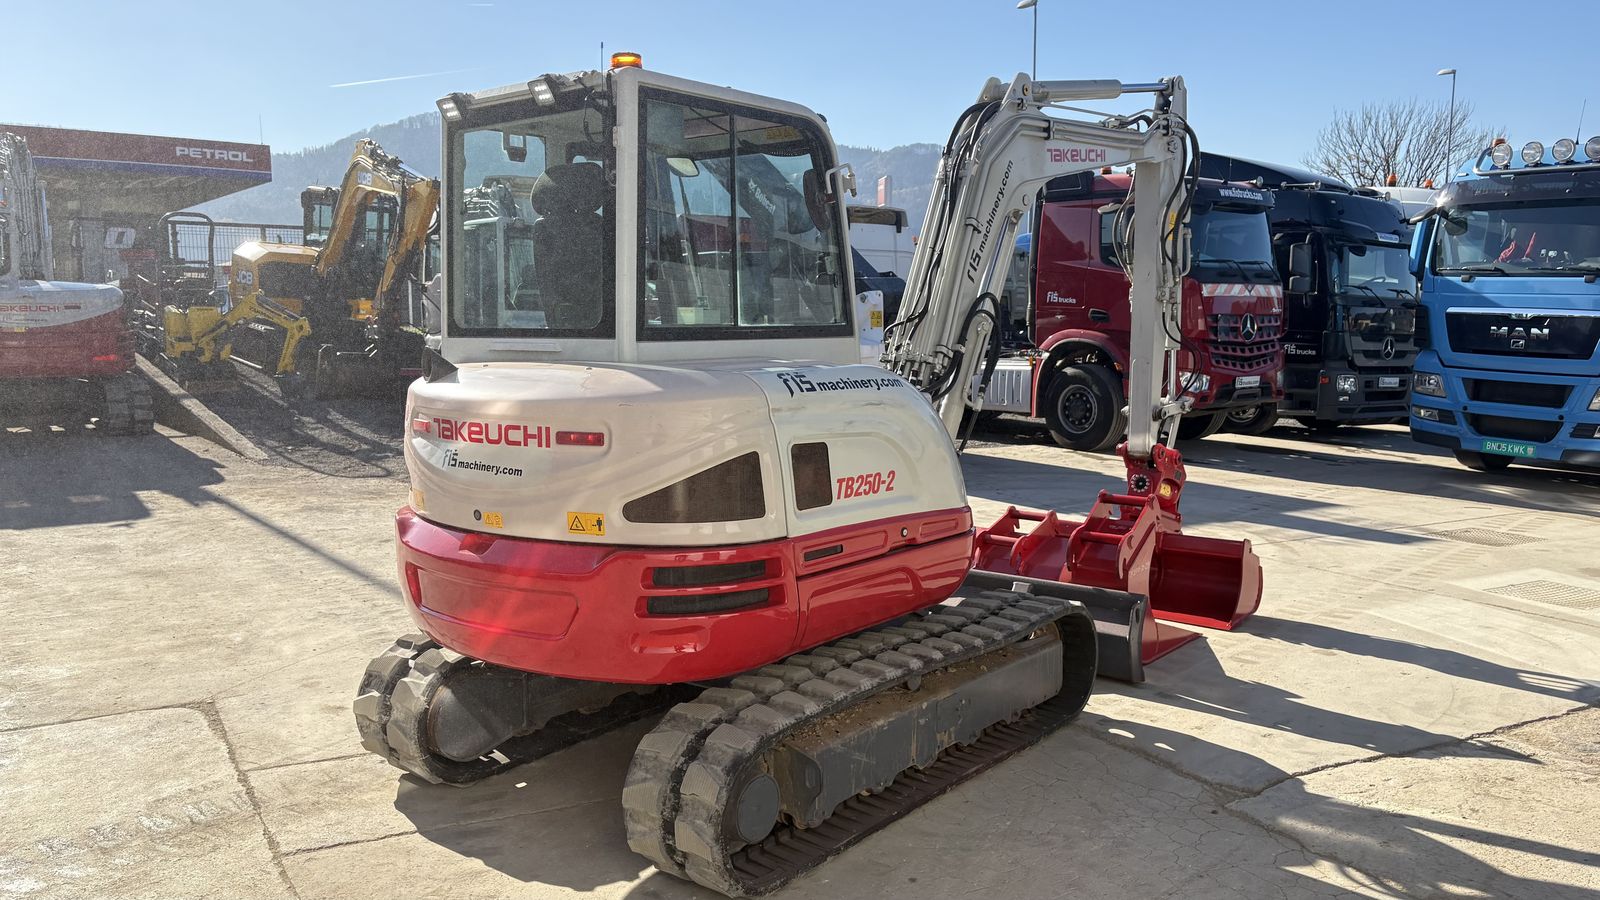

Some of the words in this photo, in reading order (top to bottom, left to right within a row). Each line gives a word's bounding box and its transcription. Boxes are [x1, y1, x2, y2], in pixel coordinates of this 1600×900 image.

[175, 146, 254, 162] PETROL
[979, 159, 1014, 254] machinery.com
[236, 270, 253, 285] JCB
[1058, 296, 1077, 304] trucks
[1489, 326, 1550, 340] MAN
[816, 378, 904, 392] machinery.com
[457, 460, 523, 477] machinery.com
[836, 470, 896, 500] TB250-2
